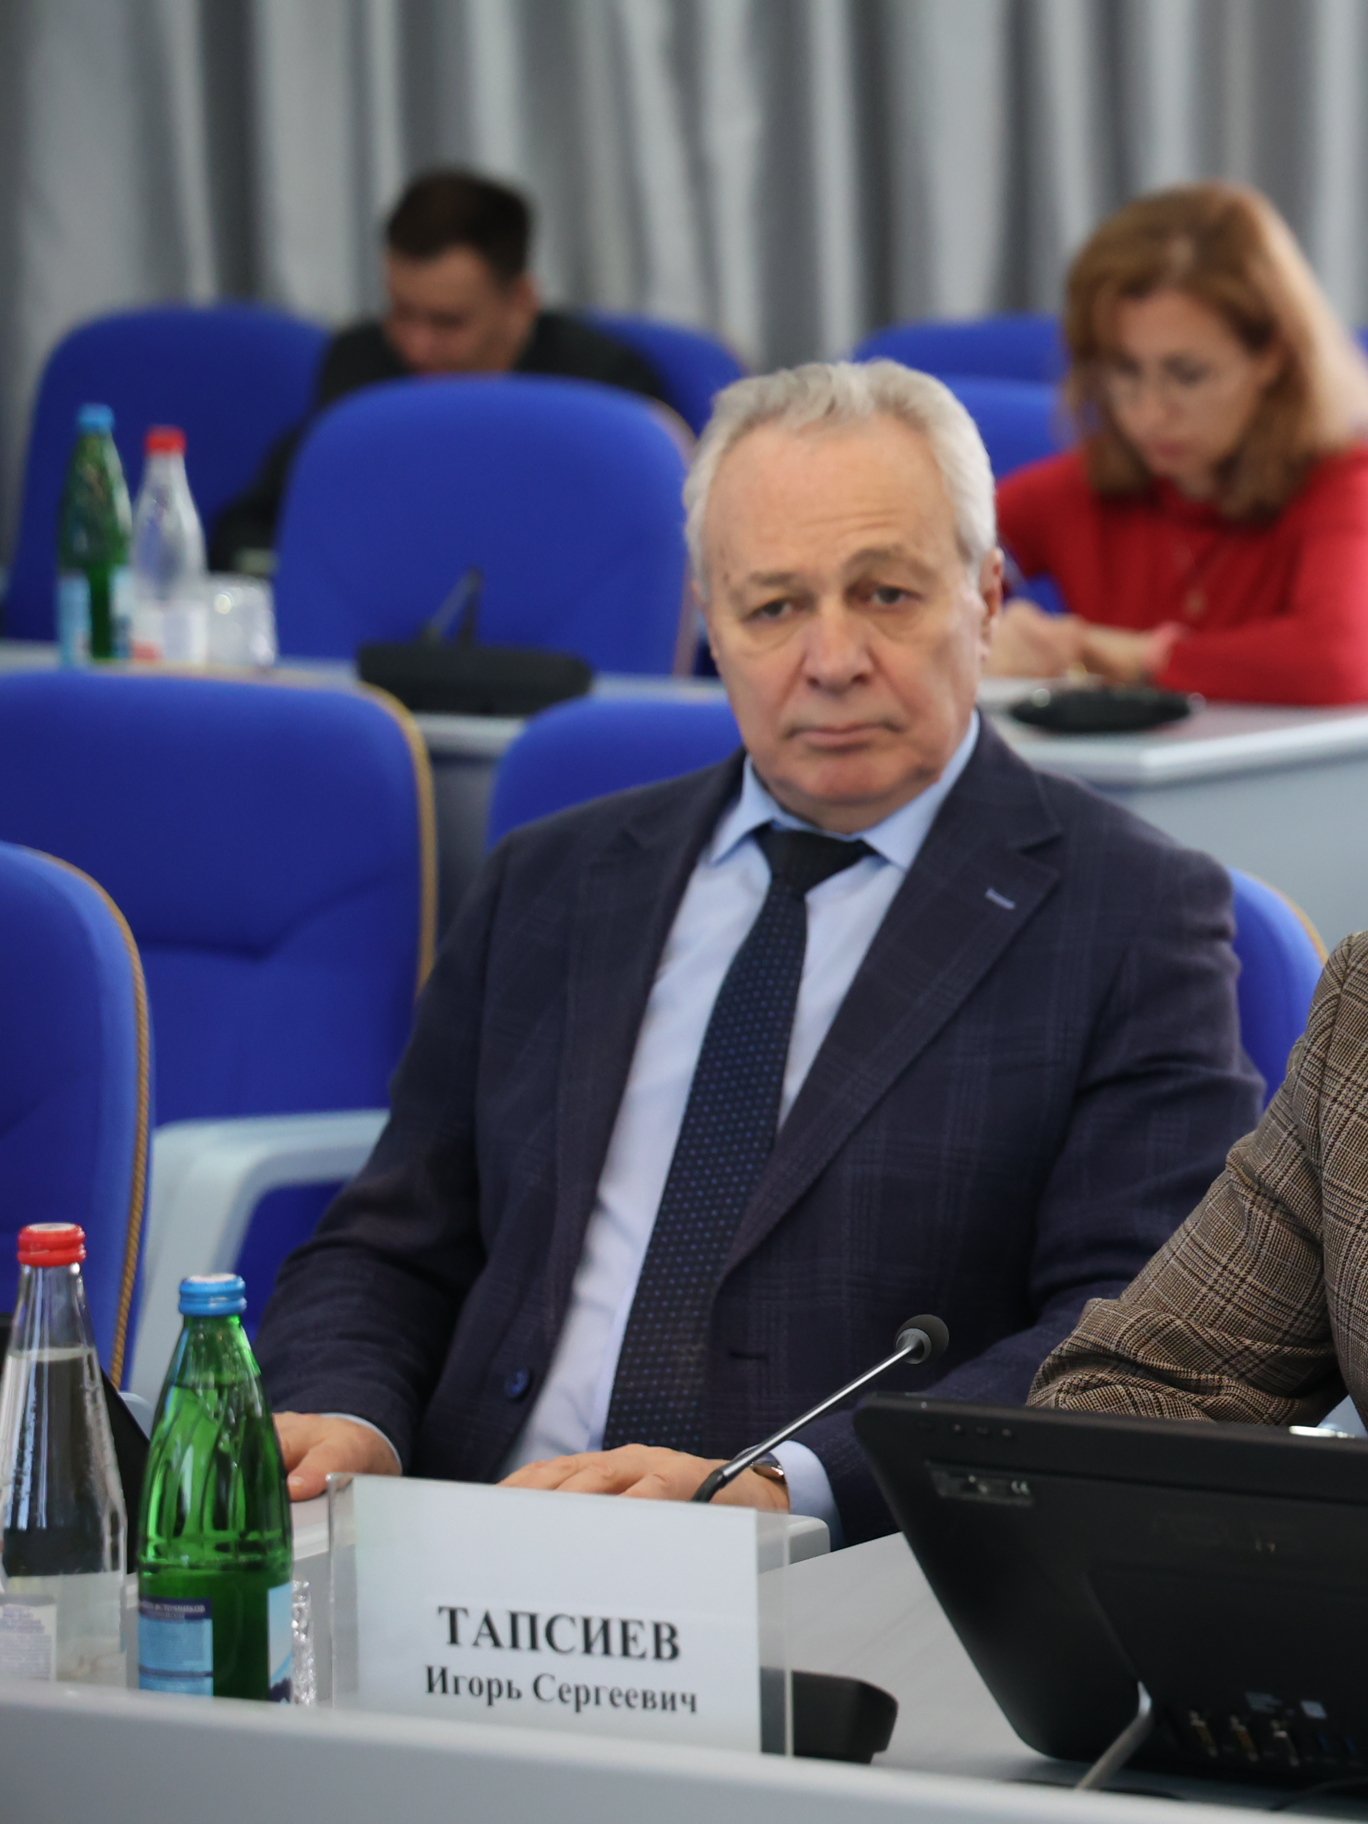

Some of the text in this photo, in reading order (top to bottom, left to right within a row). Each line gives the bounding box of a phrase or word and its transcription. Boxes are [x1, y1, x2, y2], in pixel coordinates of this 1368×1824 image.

[437, 1605, 681, 1661] ТАПСИЕВ
[425, 1664, 698, 1713] Игорь Сергеевич
